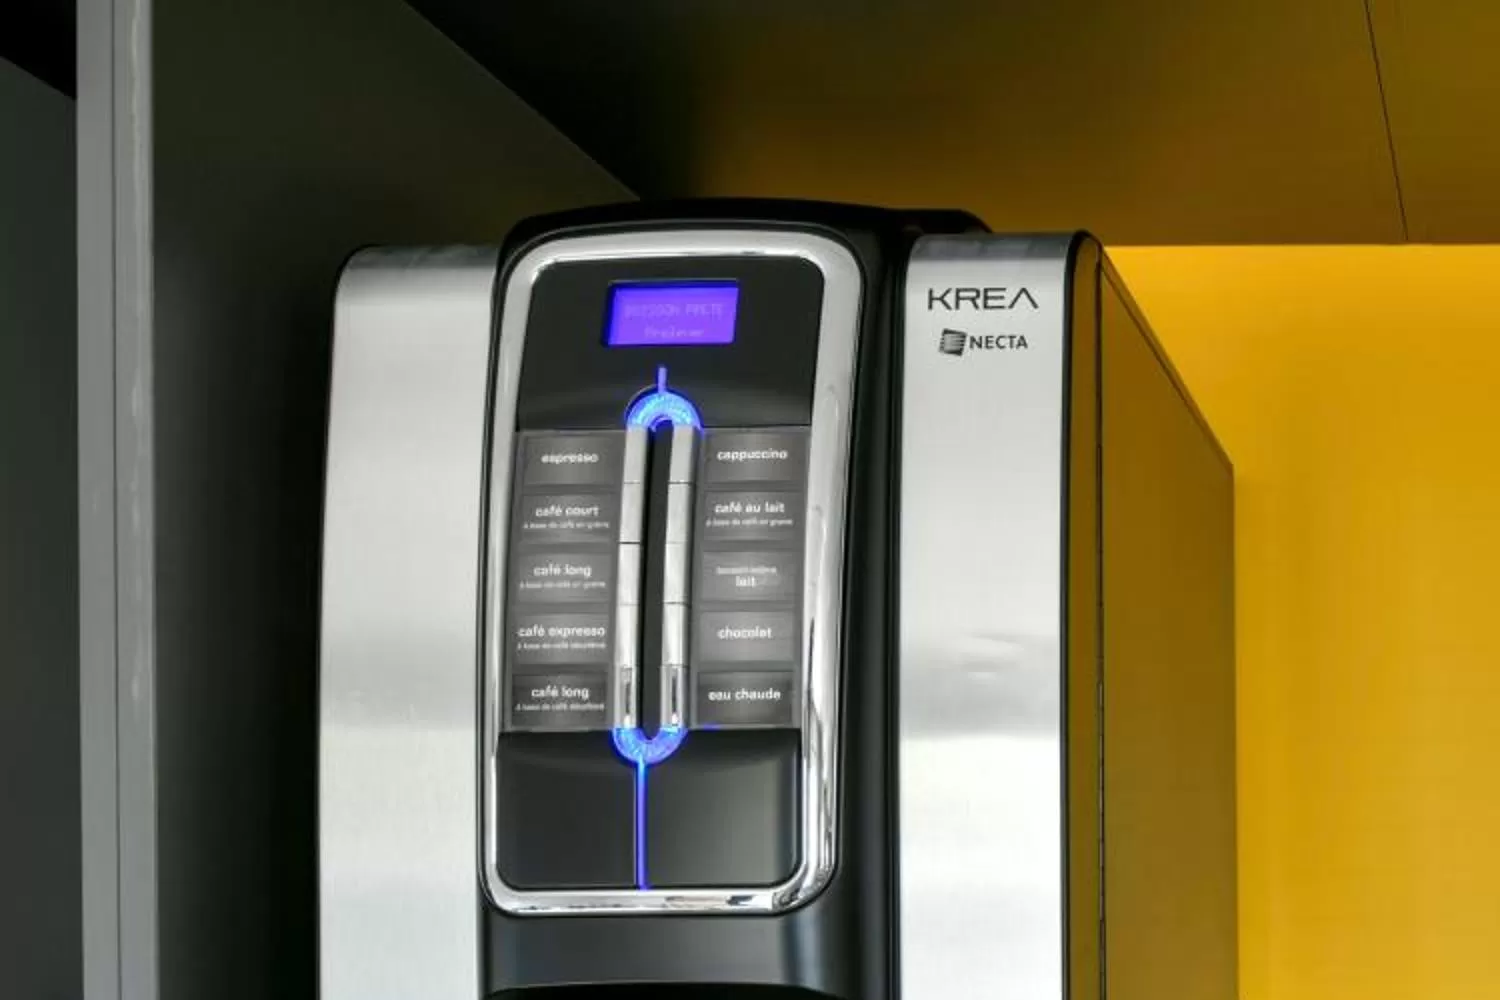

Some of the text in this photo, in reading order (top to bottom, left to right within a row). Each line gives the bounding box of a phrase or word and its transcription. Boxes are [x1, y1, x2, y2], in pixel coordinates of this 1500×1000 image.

[928, 286, 1039, 311] KREA
[969, 334, 1029, 350] NECTA
[716, 448, 789, 462] cappuccino
[535, 504, 600, 517] café court
[714, 501, 785, 513] café au lait
[533, 563, 593, 578] café long
[517, 624, 546, 637] café
[717, 626, 773, 640] chocolat
[531, 684, 590, 701] café long
[707, 687, 782, 702] eau chaude
